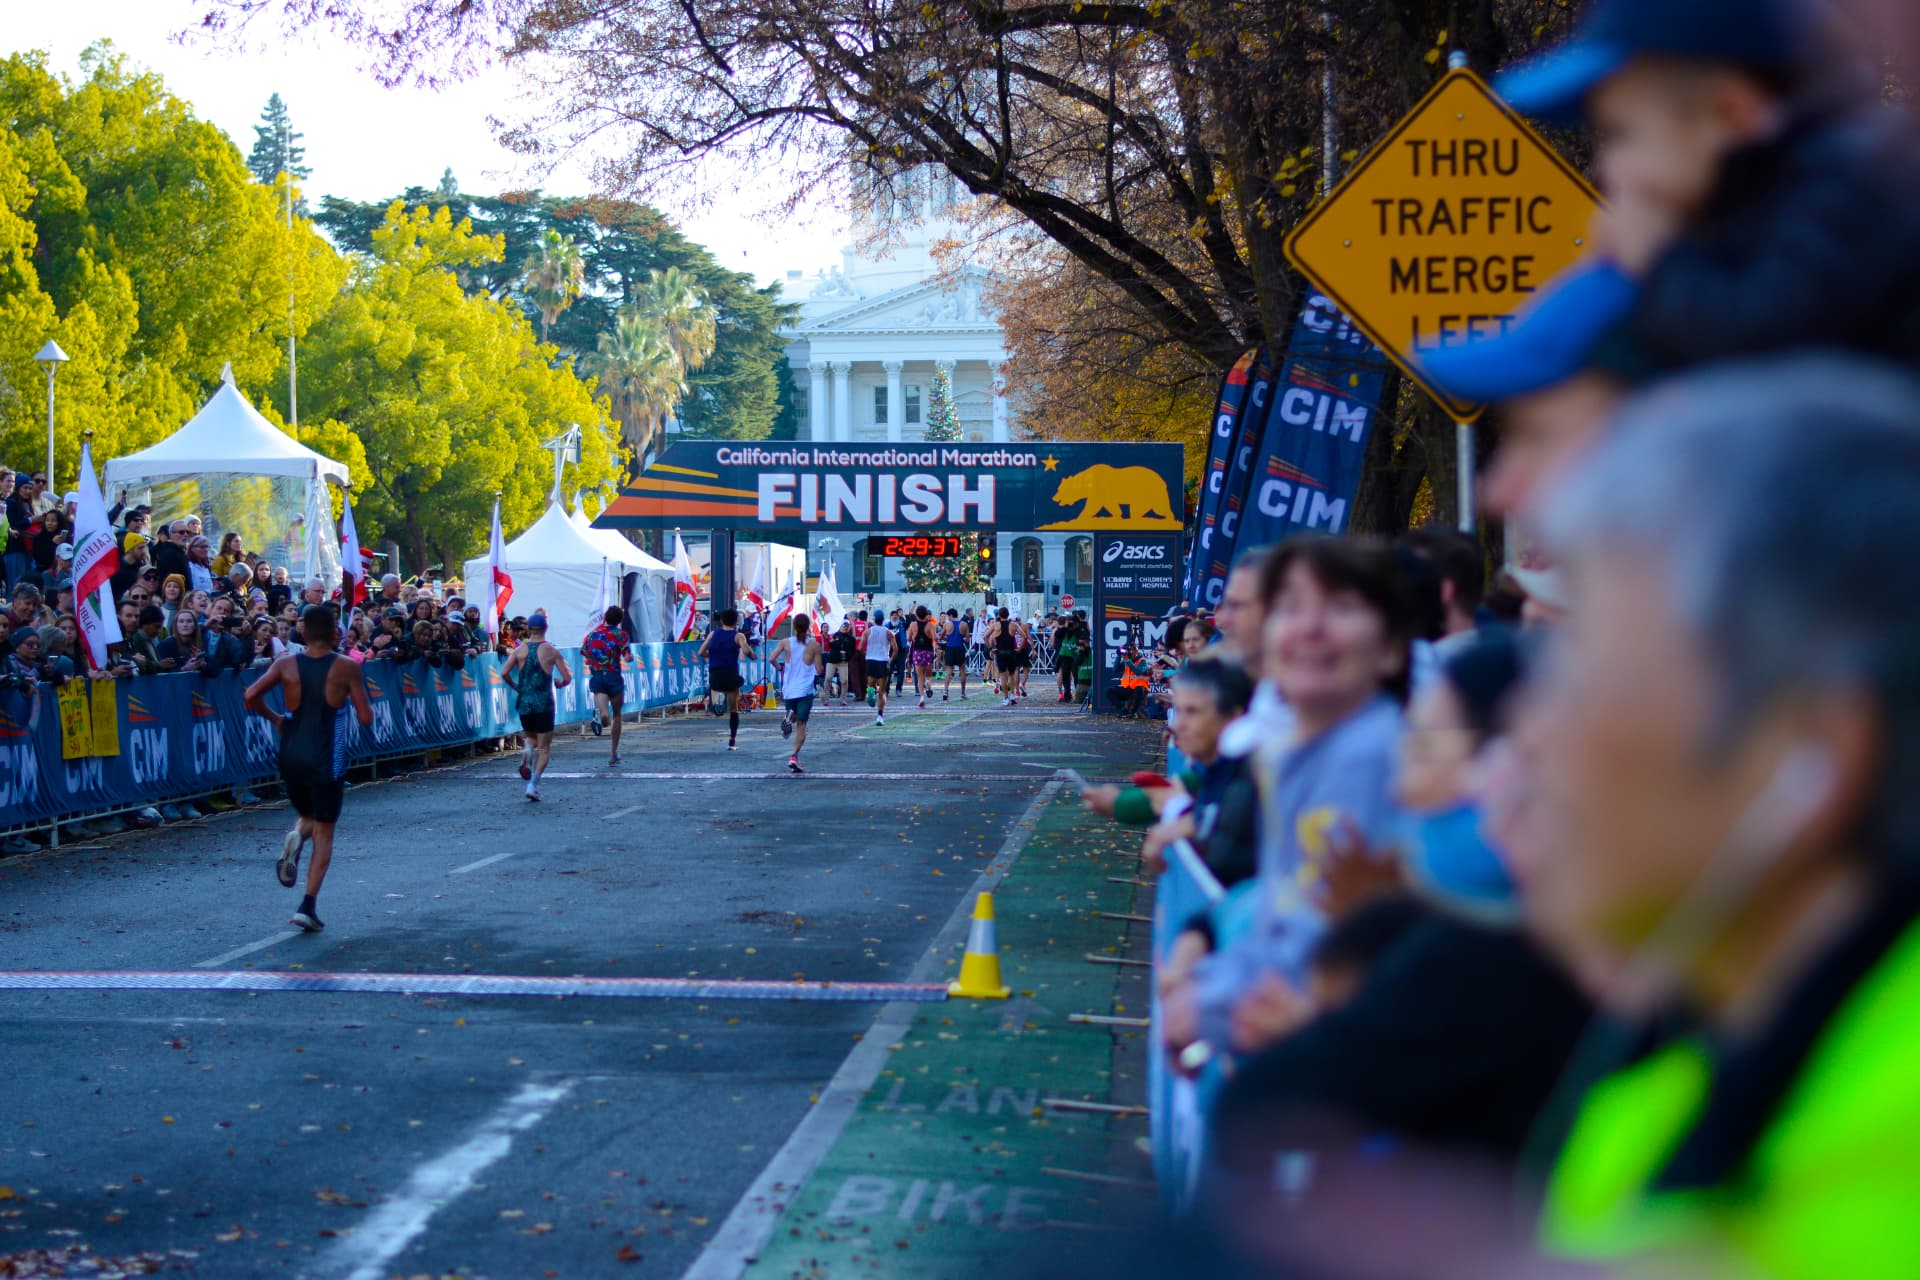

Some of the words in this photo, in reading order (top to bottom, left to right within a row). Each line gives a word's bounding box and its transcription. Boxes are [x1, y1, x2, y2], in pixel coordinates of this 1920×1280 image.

[1405, 139, 1519, 176] THRU
[1372, 196, 1551, 236] TRAFFIC
[1390, 256, 1536, 294] MERGE
[1280, 387, 1368, 443] CIM
[716, 447, 809, 466] California
[813, 448, 937, 466] International
[941, 449, 1037, 466] Marathon
[757, 473, 995, 523] FINISH
[1257, 479, 1346, 535] CIM
[130, 728, 168, 783] CIM
[191, 722, 224, 775] CIM
[827, 1173, 1061, 1231] BIKE
